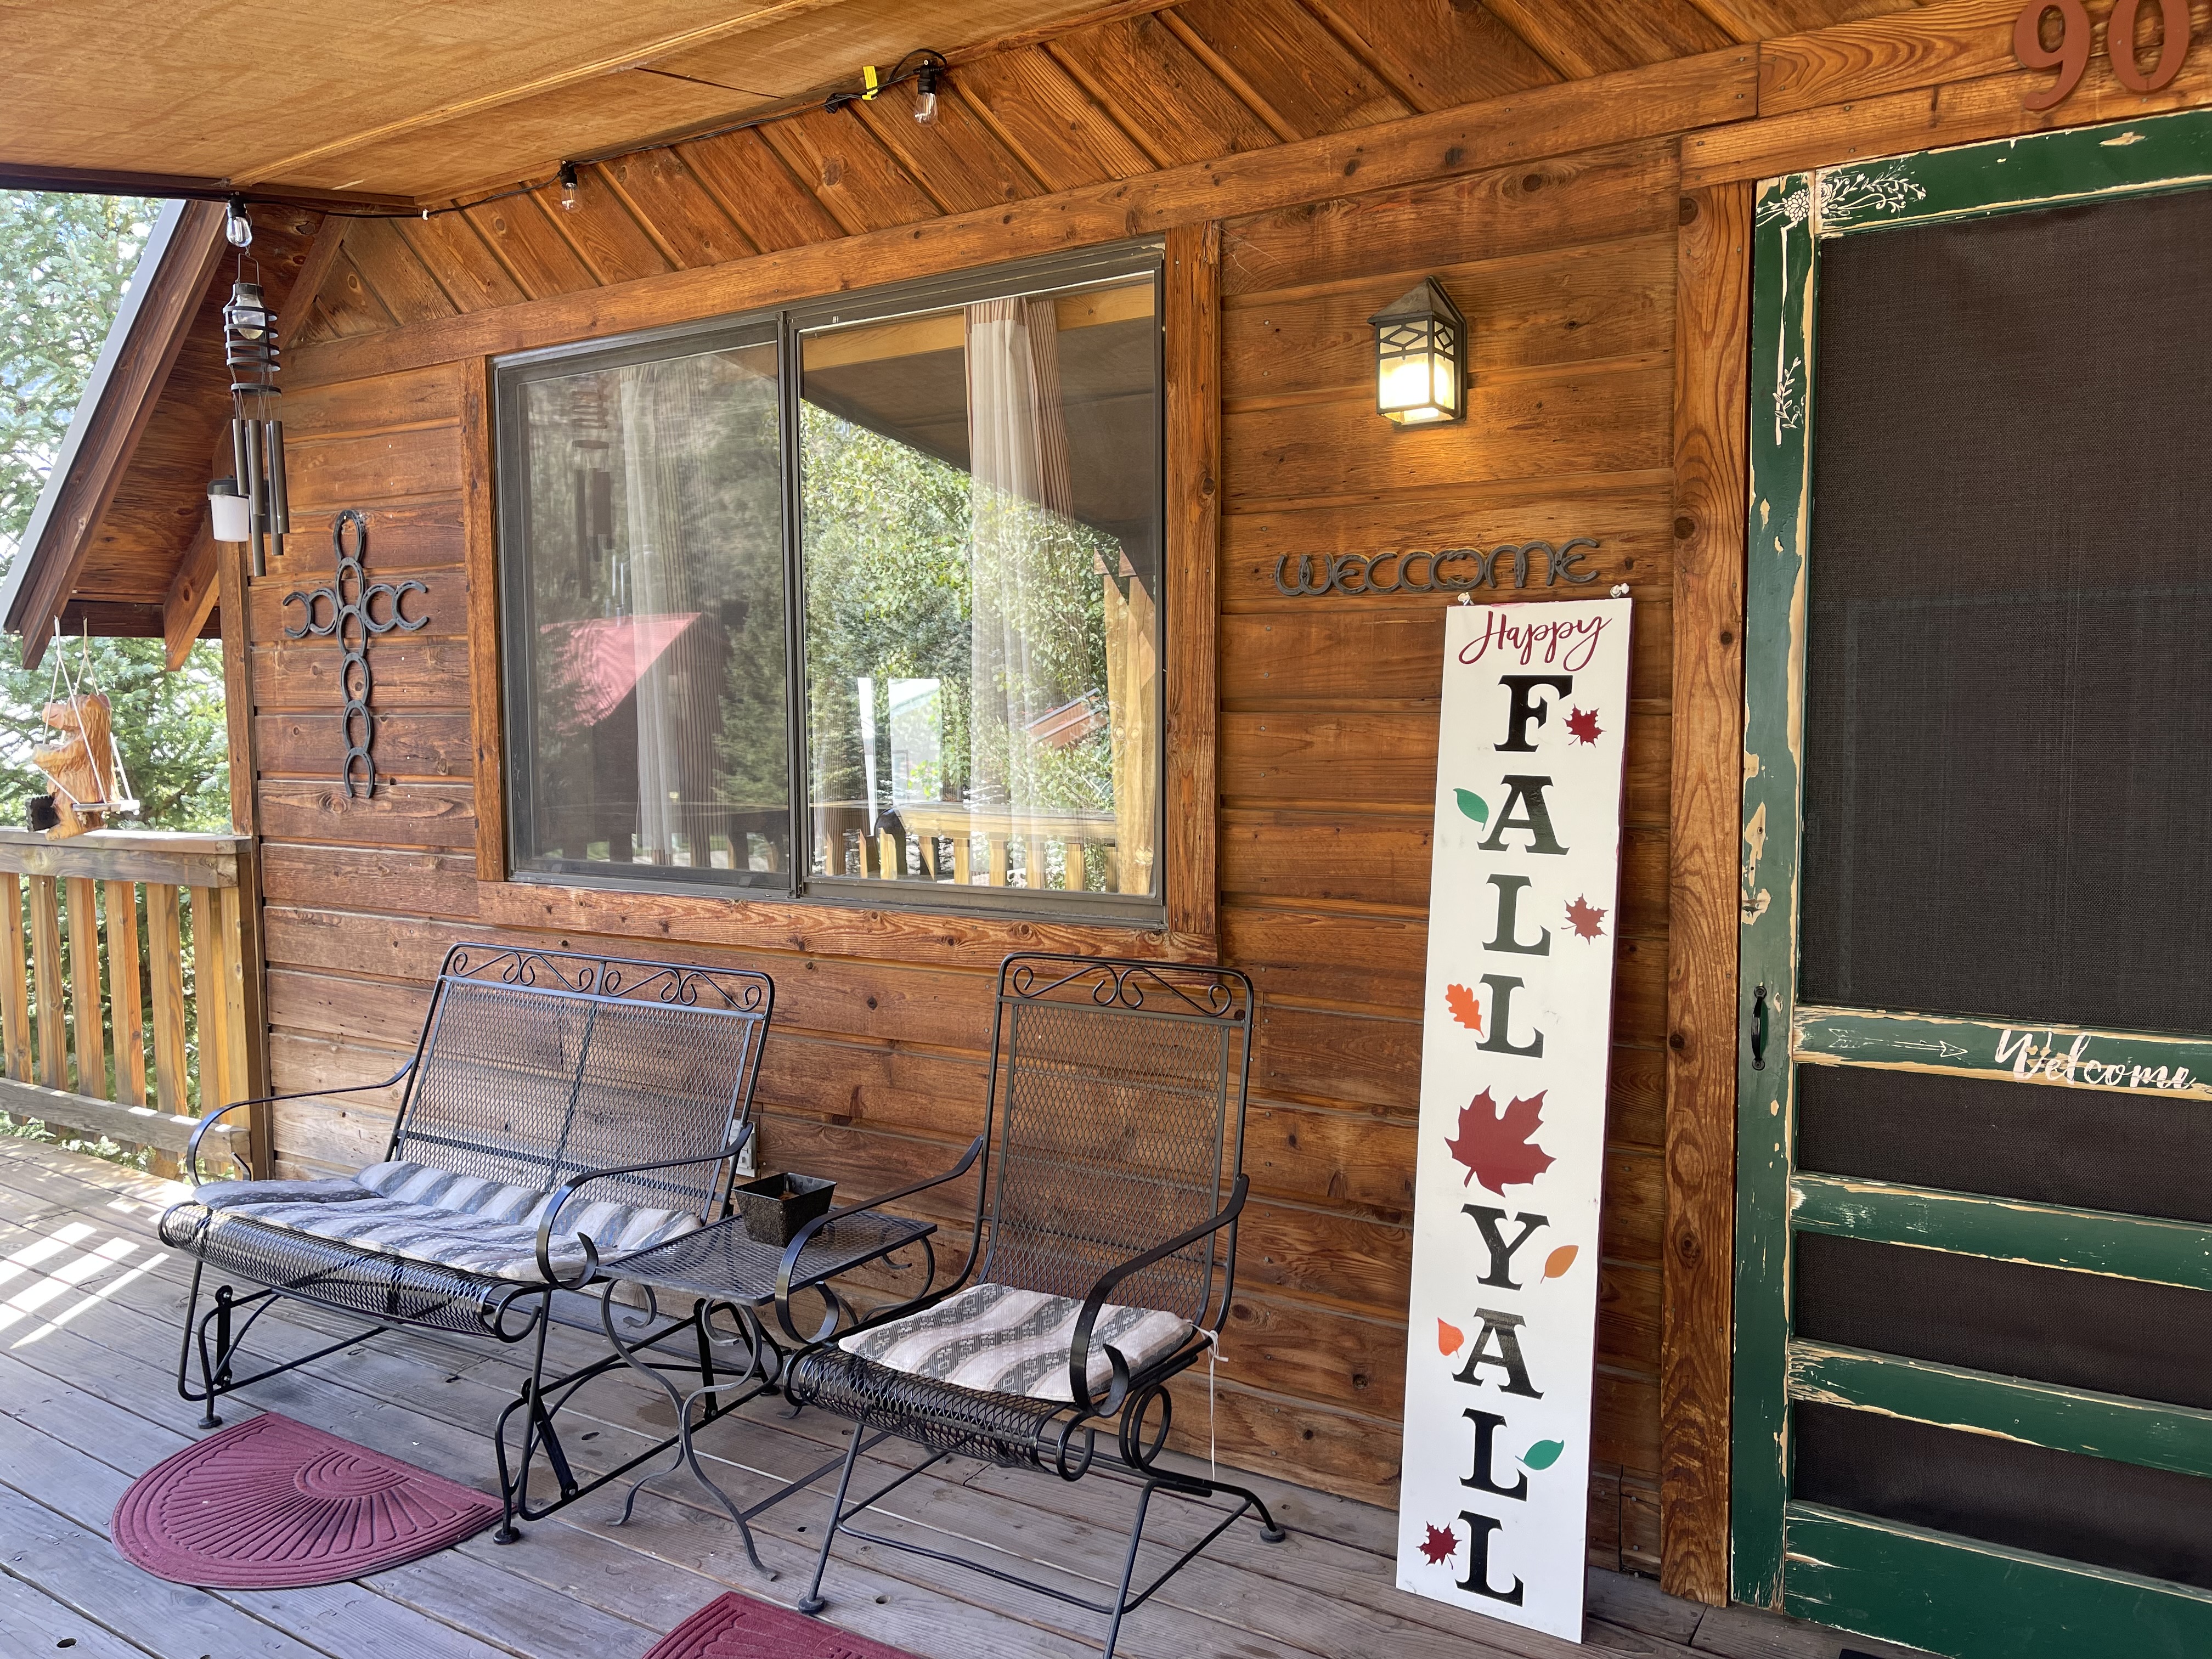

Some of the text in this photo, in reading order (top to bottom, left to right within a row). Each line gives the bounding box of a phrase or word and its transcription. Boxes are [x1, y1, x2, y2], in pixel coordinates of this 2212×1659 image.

[2013, 0, 2191, 110] 90
[1458, 610, 1613, 672] Happy
[1475, 674, 1573, 1059] FALL
[1994, 1028, 2197, 1088] Welcome
[1451, 1203, 1551, 1607] YALL
